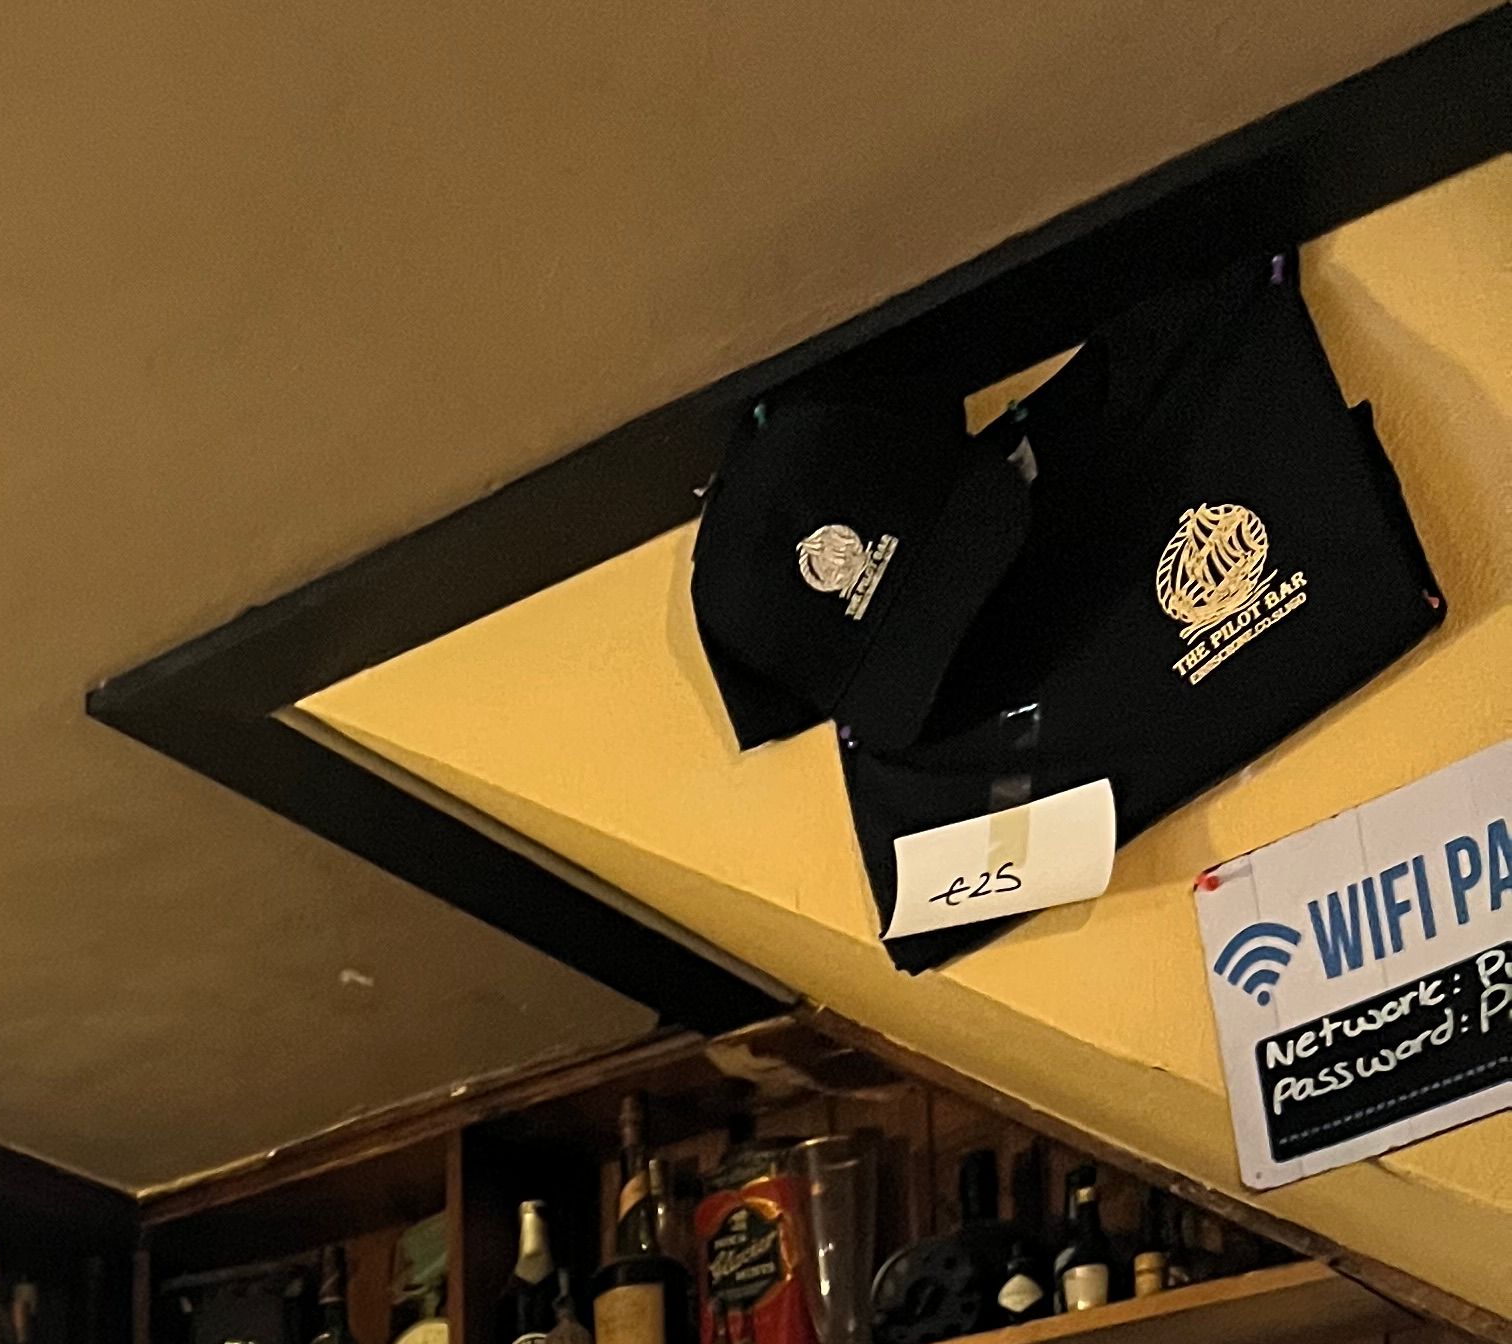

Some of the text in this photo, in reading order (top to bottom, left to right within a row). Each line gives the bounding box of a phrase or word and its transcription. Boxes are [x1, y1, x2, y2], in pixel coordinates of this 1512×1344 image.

[1172, 571, 1308, 675] THE PILOT BAR
[1307, 854, 1437, 980] WIFI
